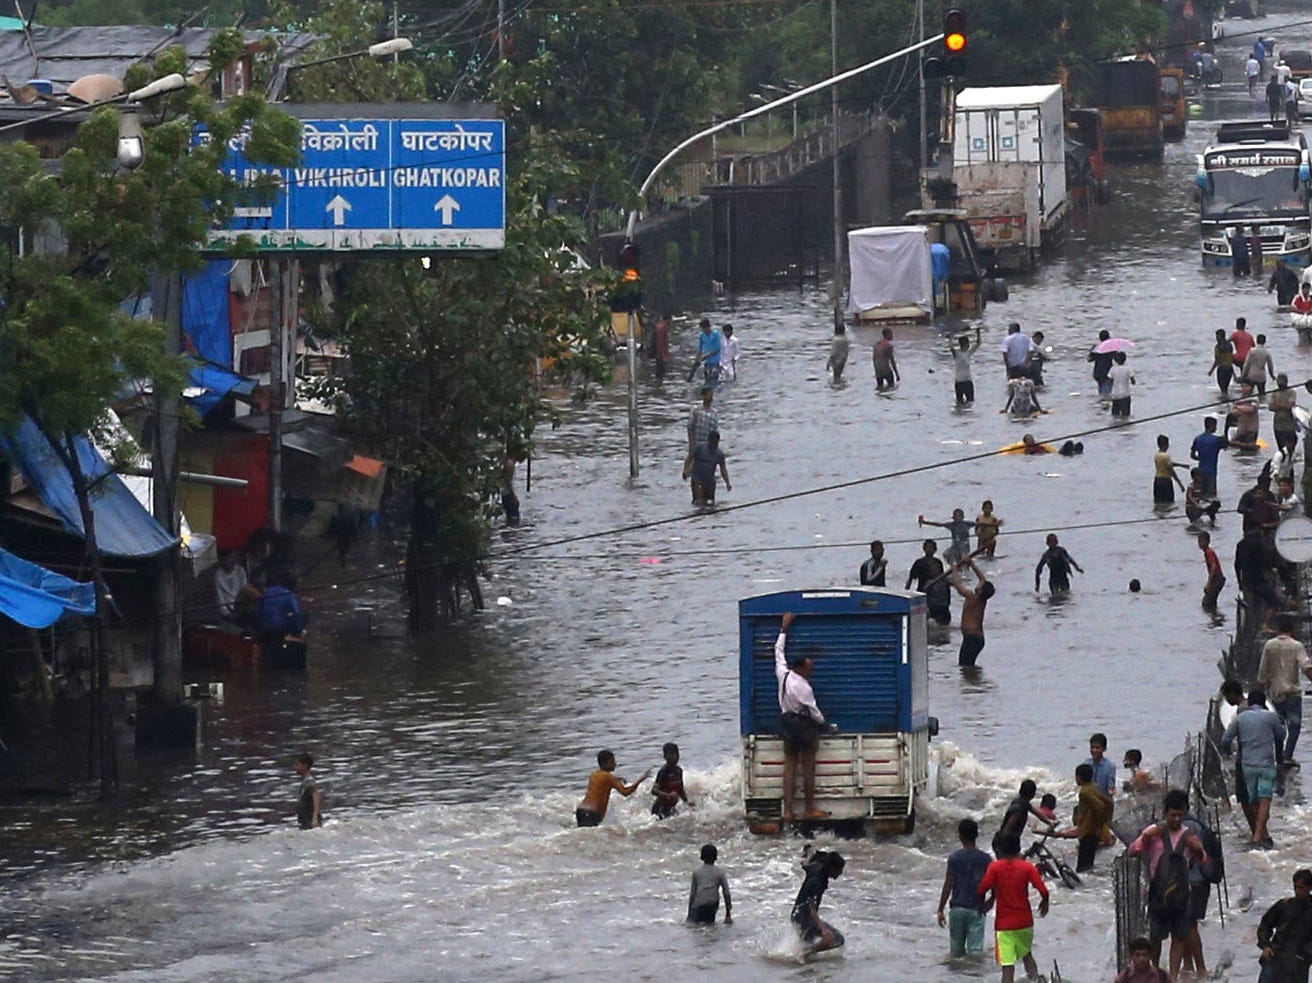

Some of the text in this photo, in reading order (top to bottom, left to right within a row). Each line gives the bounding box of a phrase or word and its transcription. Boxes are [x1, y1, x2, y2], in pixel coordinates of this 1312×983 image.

[401, 124, 494, 151] घाटकोपर
[295, 168, 386, 188] VIKHROLI
[393, 168, 500, 188] GHATKOPAR
